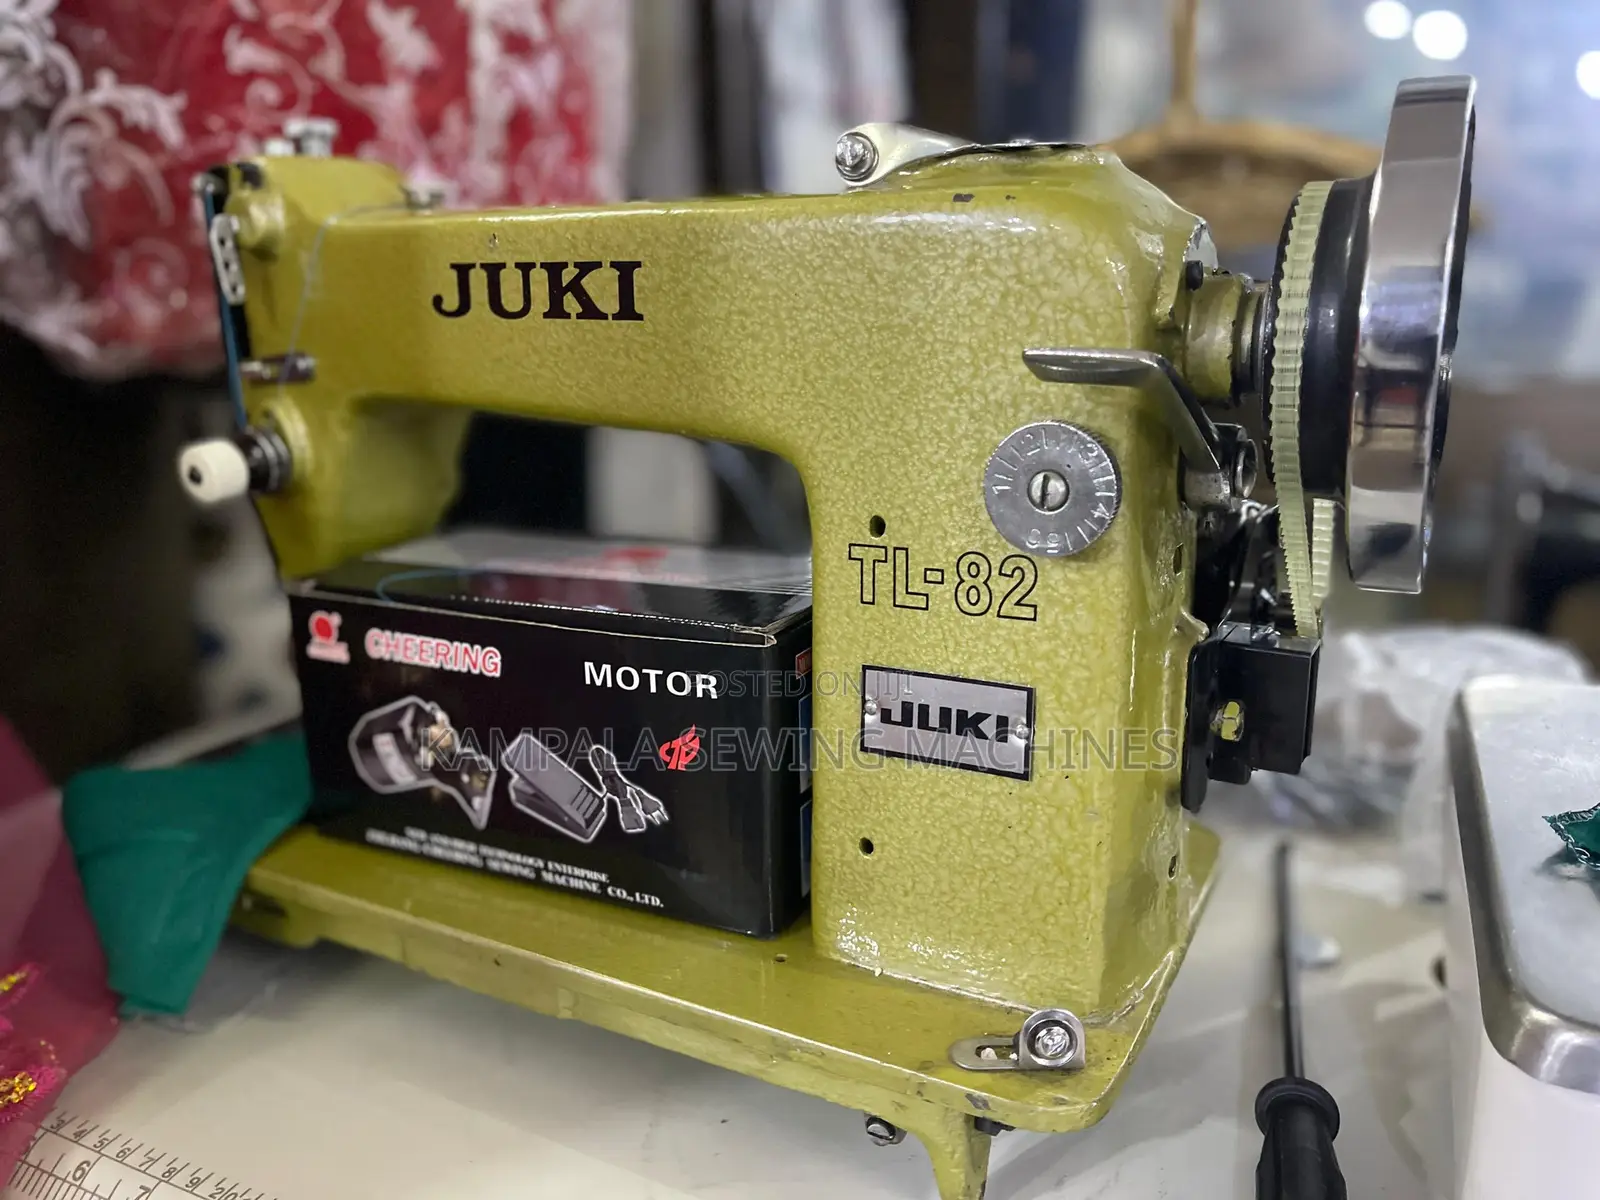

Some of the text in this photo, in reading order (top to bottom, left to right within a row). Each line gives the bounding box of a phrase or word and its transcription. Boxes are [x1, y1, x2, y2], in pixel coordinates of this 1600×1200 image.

[432, 261, 644, 321] JUKI
[848, 543, 1039, 622] TL-82
[365, 628, 502, 678] CHEERING
[584, 661, 718, 700] MOTOR
[880, 700, 1010, 744] JUKI
[72, 1160, 91, 1182] 6
[161, 1166, 177, 1179] 8
[185, 1176, 201, 1189] 9
